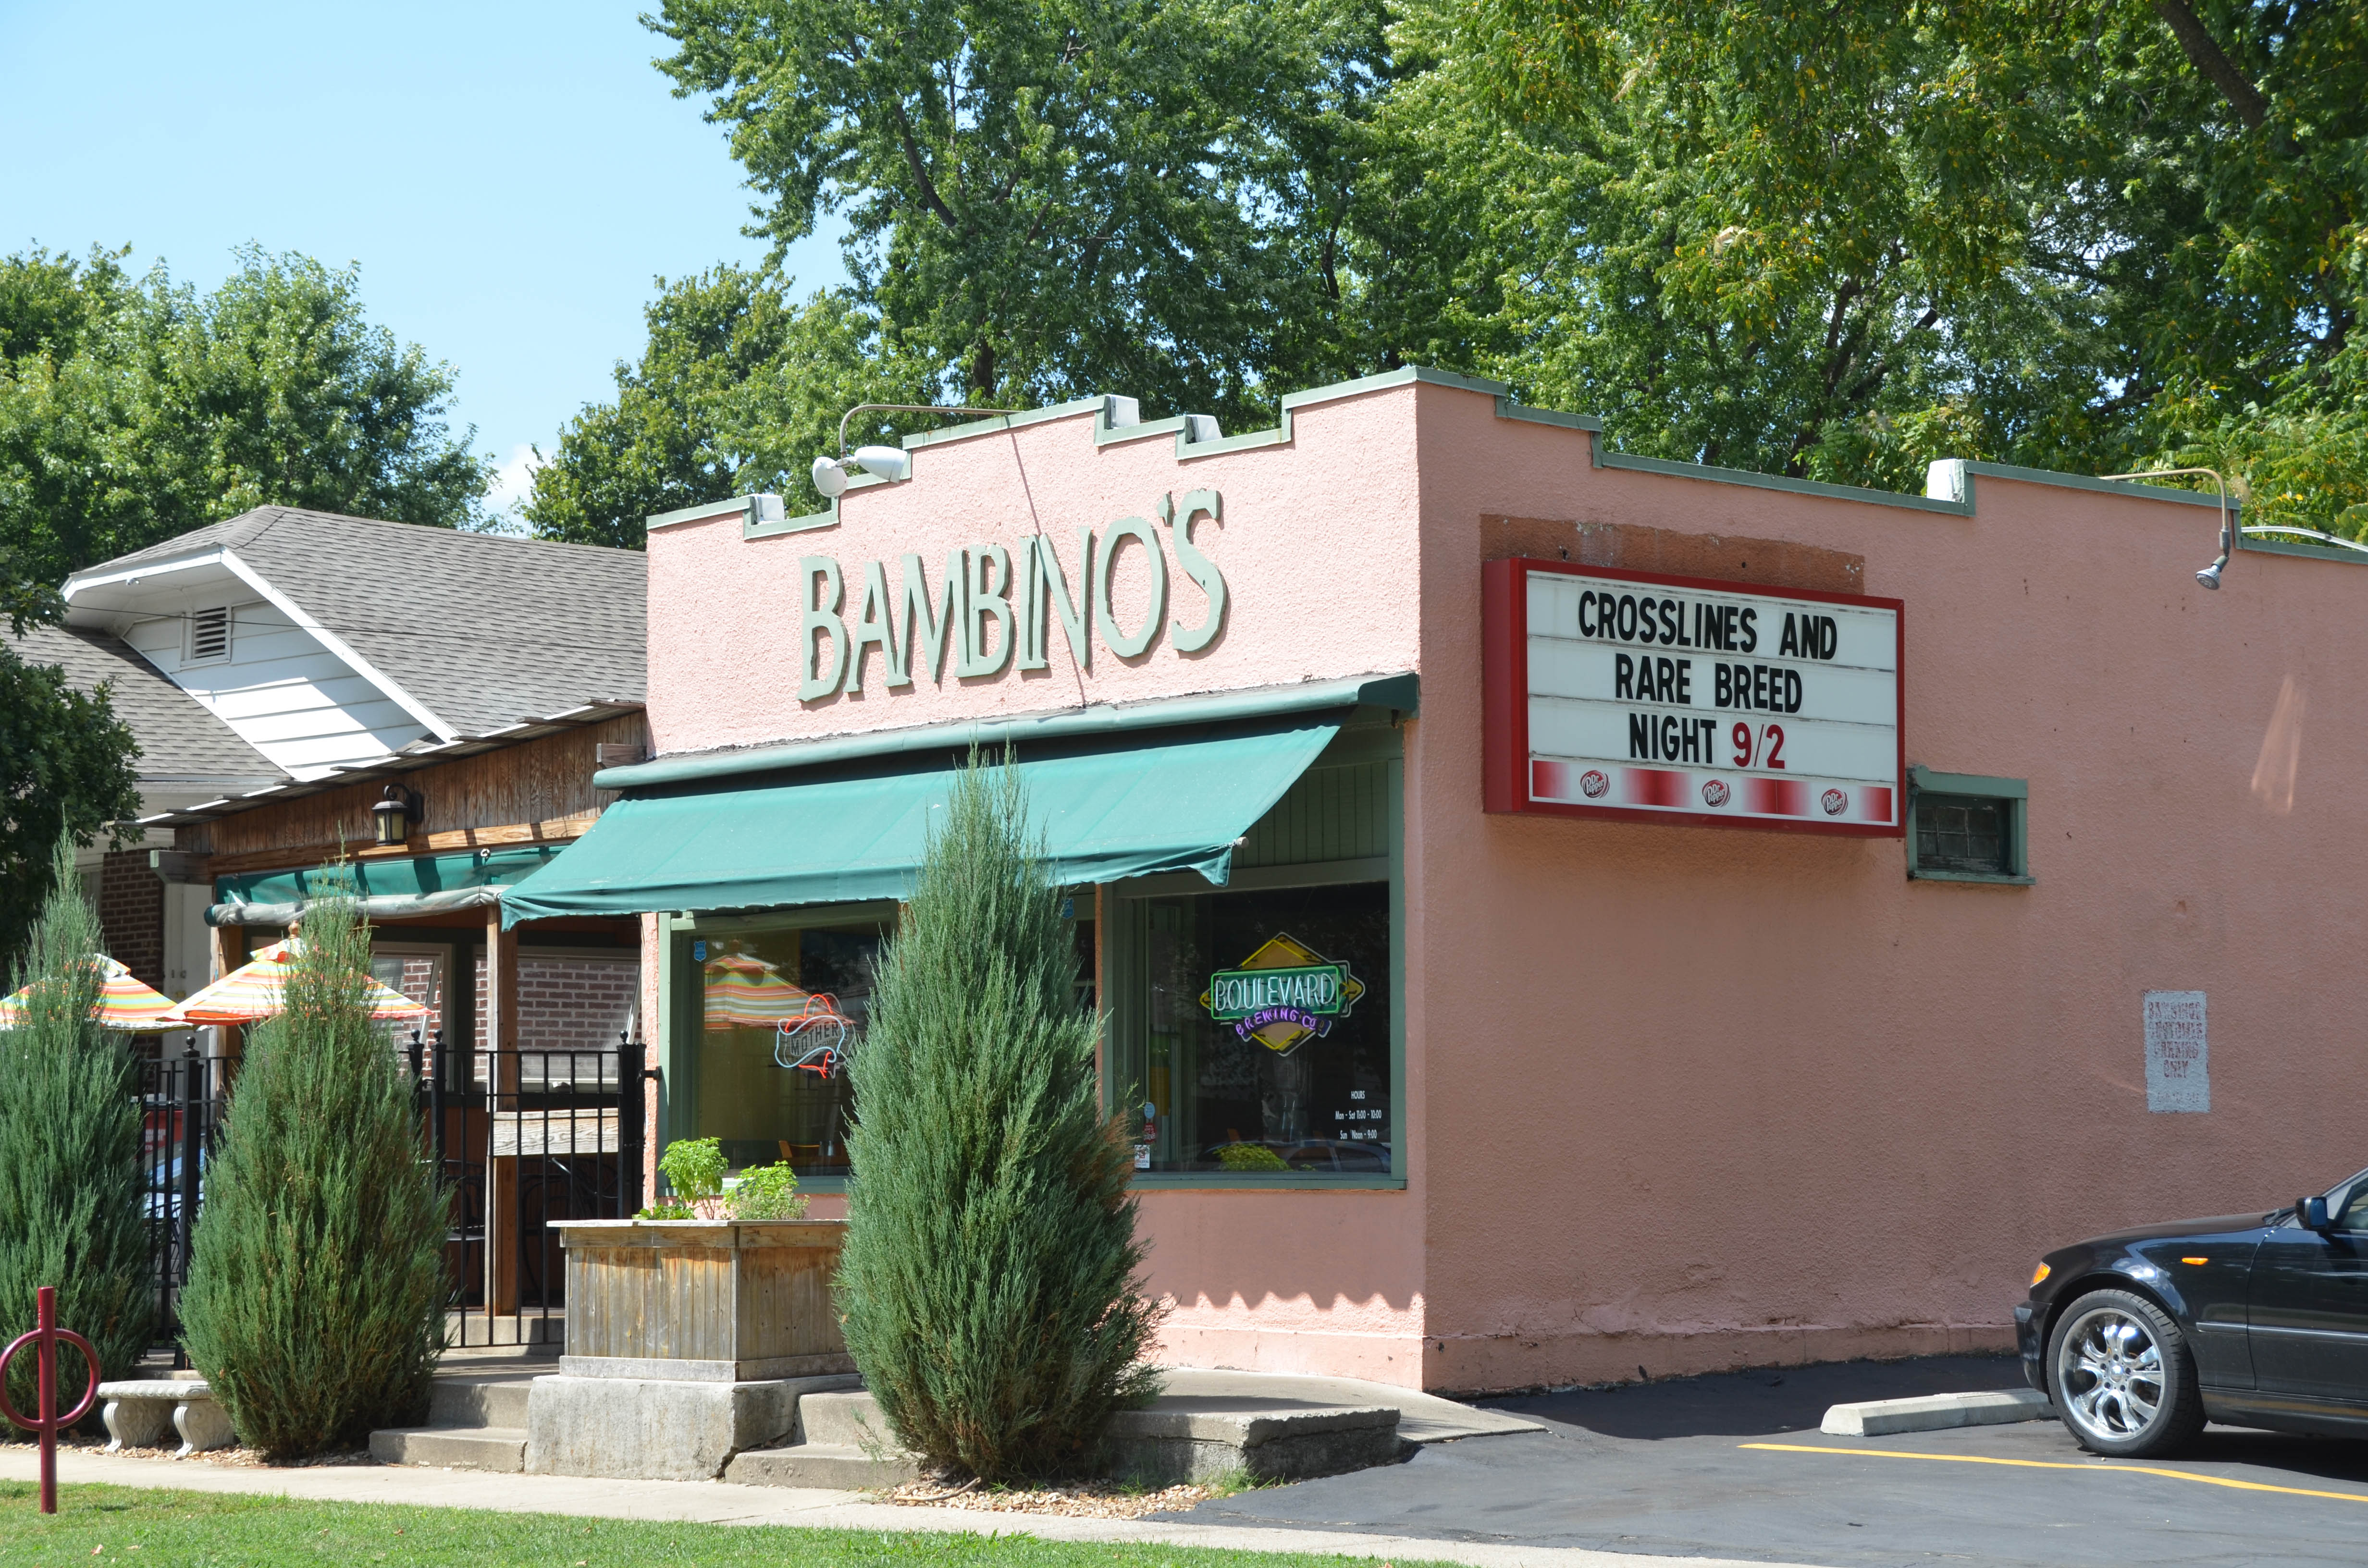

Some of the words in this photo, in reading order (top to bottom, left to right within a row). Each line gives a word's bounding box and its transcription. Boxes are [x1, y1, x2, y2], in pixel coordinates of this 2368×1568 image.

[796, 488, 1228, 702] BAMBINO'S
[1579, 590, 1757, 653] CROSSLINES
[1779, 612, 1838, 661] AND
[1616, 653, 1691, 704] RARE
[1715, 663, 1802, 713] BREED
[1629, 713, 1716, 764] NIGHT
[1732, 722, 1785, 769] 9/2
[1585, 776, 1604, 794] Pepper
[1591, 774, 1599, 784] Dr
[1707, 786, 1725, 803] Pepper
[1713, 784, 1720, 793] Dr
[1825, 795, 1842, 812] Pepper
[1831, 793, 1838, 802] Dr
[1215, 973, 1334, 1011] BOULEVARD
[1235, 1008, 1299, 1035] BREWING
[1351, 1090, 1365, 1099] HOURS
[1335, 1110, 1344, 1120] Mon
[1357, 1110, 1366, 1119] 11:00
[1370, 1109, 1382, 1119] 10:00
[1352, 1130, 1363, 1139] Noon
[1368, 1129, 1377, 1139] 9:00
